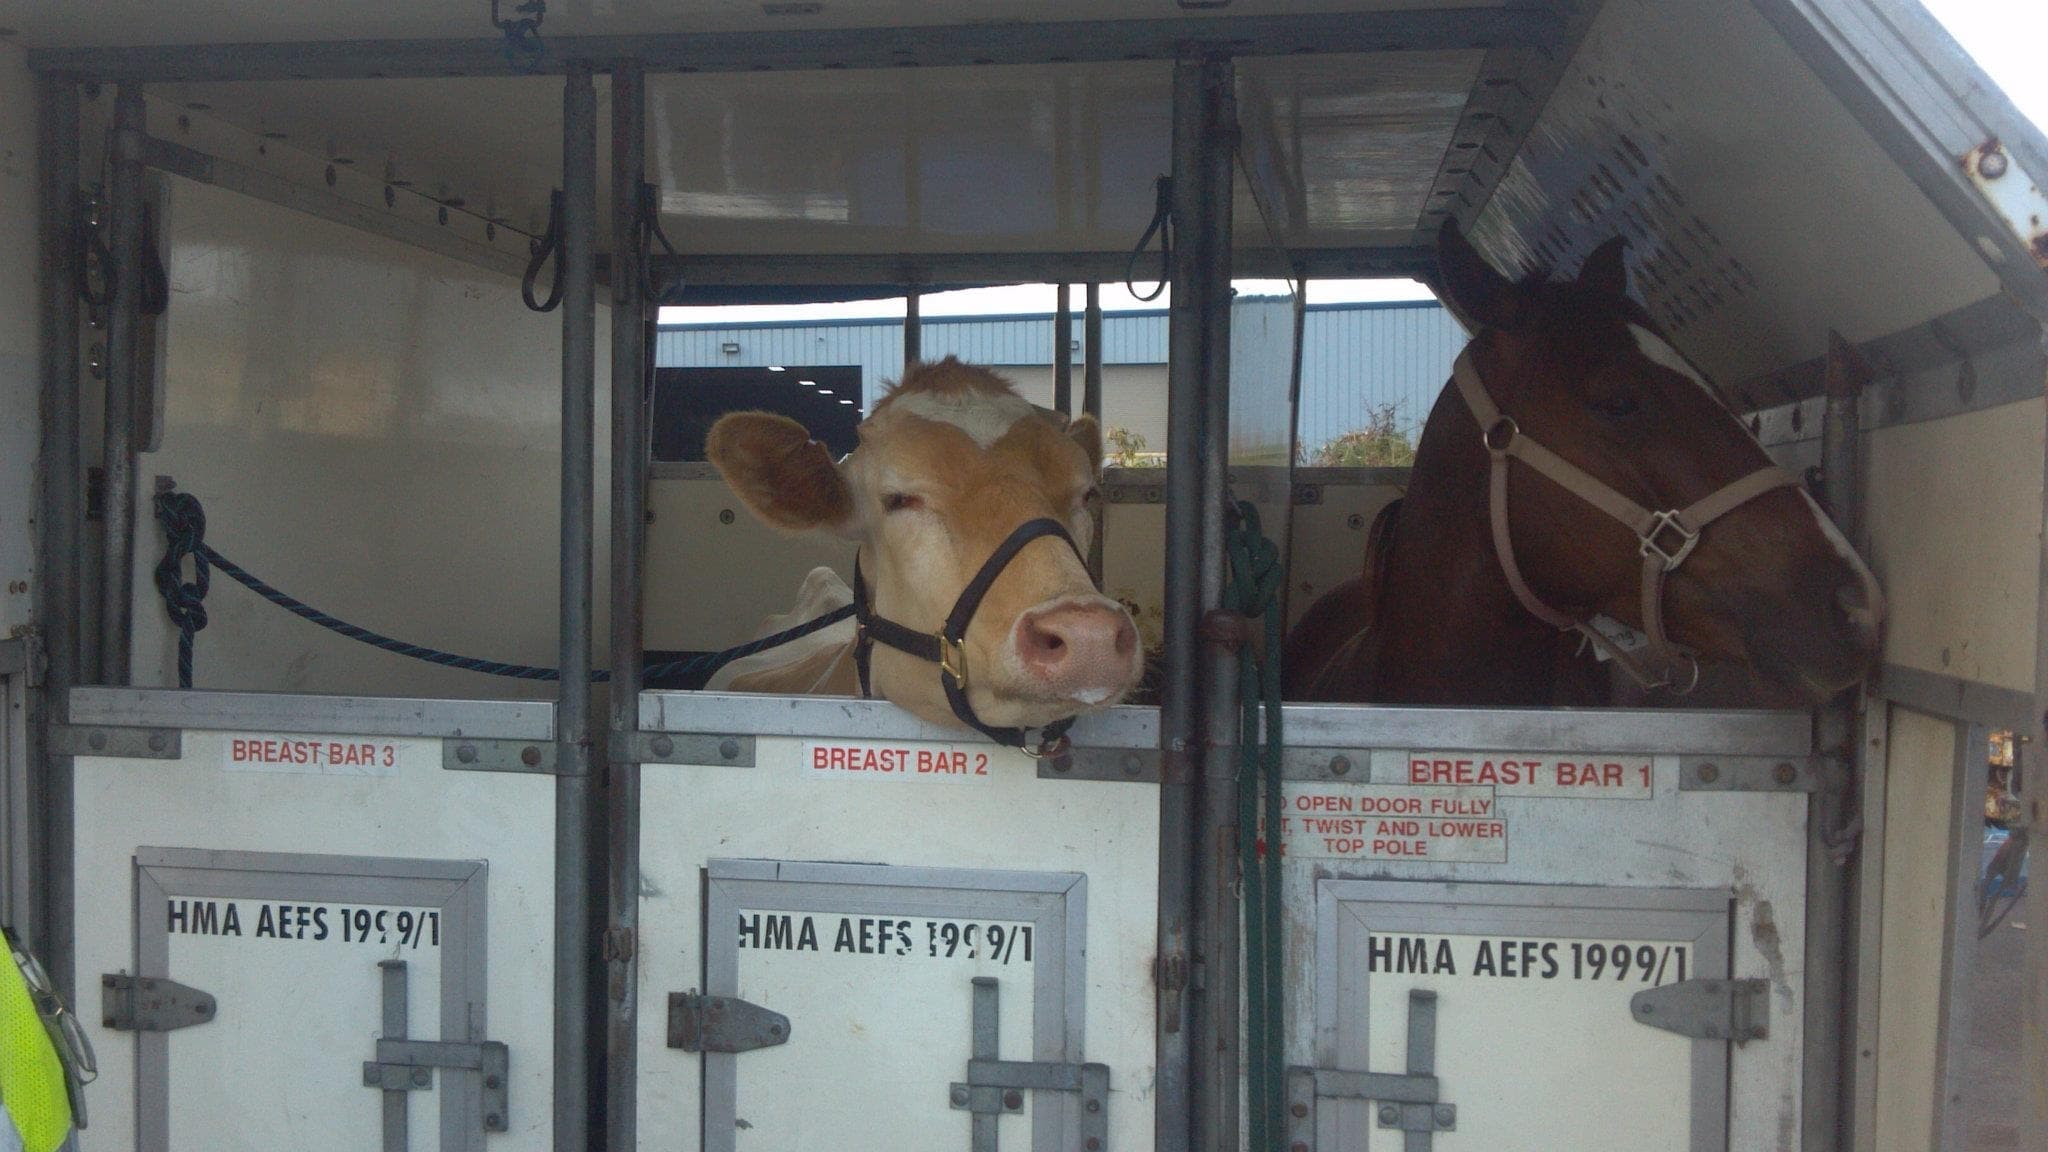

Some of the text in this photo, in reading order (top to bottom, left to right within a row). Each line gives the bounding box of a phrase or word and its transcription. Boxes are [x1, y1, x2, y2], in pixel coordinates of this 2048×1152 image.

[233, 740, 394, 767] BREAST BAR 3
[813, 747, 988, 775] BREAST BAR 2
[1411, 760, 1651, 788] BREAST BAR 1
[1296, 795, 1352, 811] OPEN
[1361, 797, 1422, 813] DOOR
[1431, 799, 1491, 815] FULLY
[1303, 818, 1367, 834] TWIST
[1376, 820, 1420, 836] AND
[1428, 822, 1504, 838] LOWER
[1324, 838, 1427, 855] TOP POLE
[168, 900, 242, 936] HMA
[256, 904, 329, 941] AEFS
[739, 913, 818, 951] HMA
[834, 917, 912, 956] AEFS
[1368, 936, 1687, 987] HMA AEFS 1999/1
